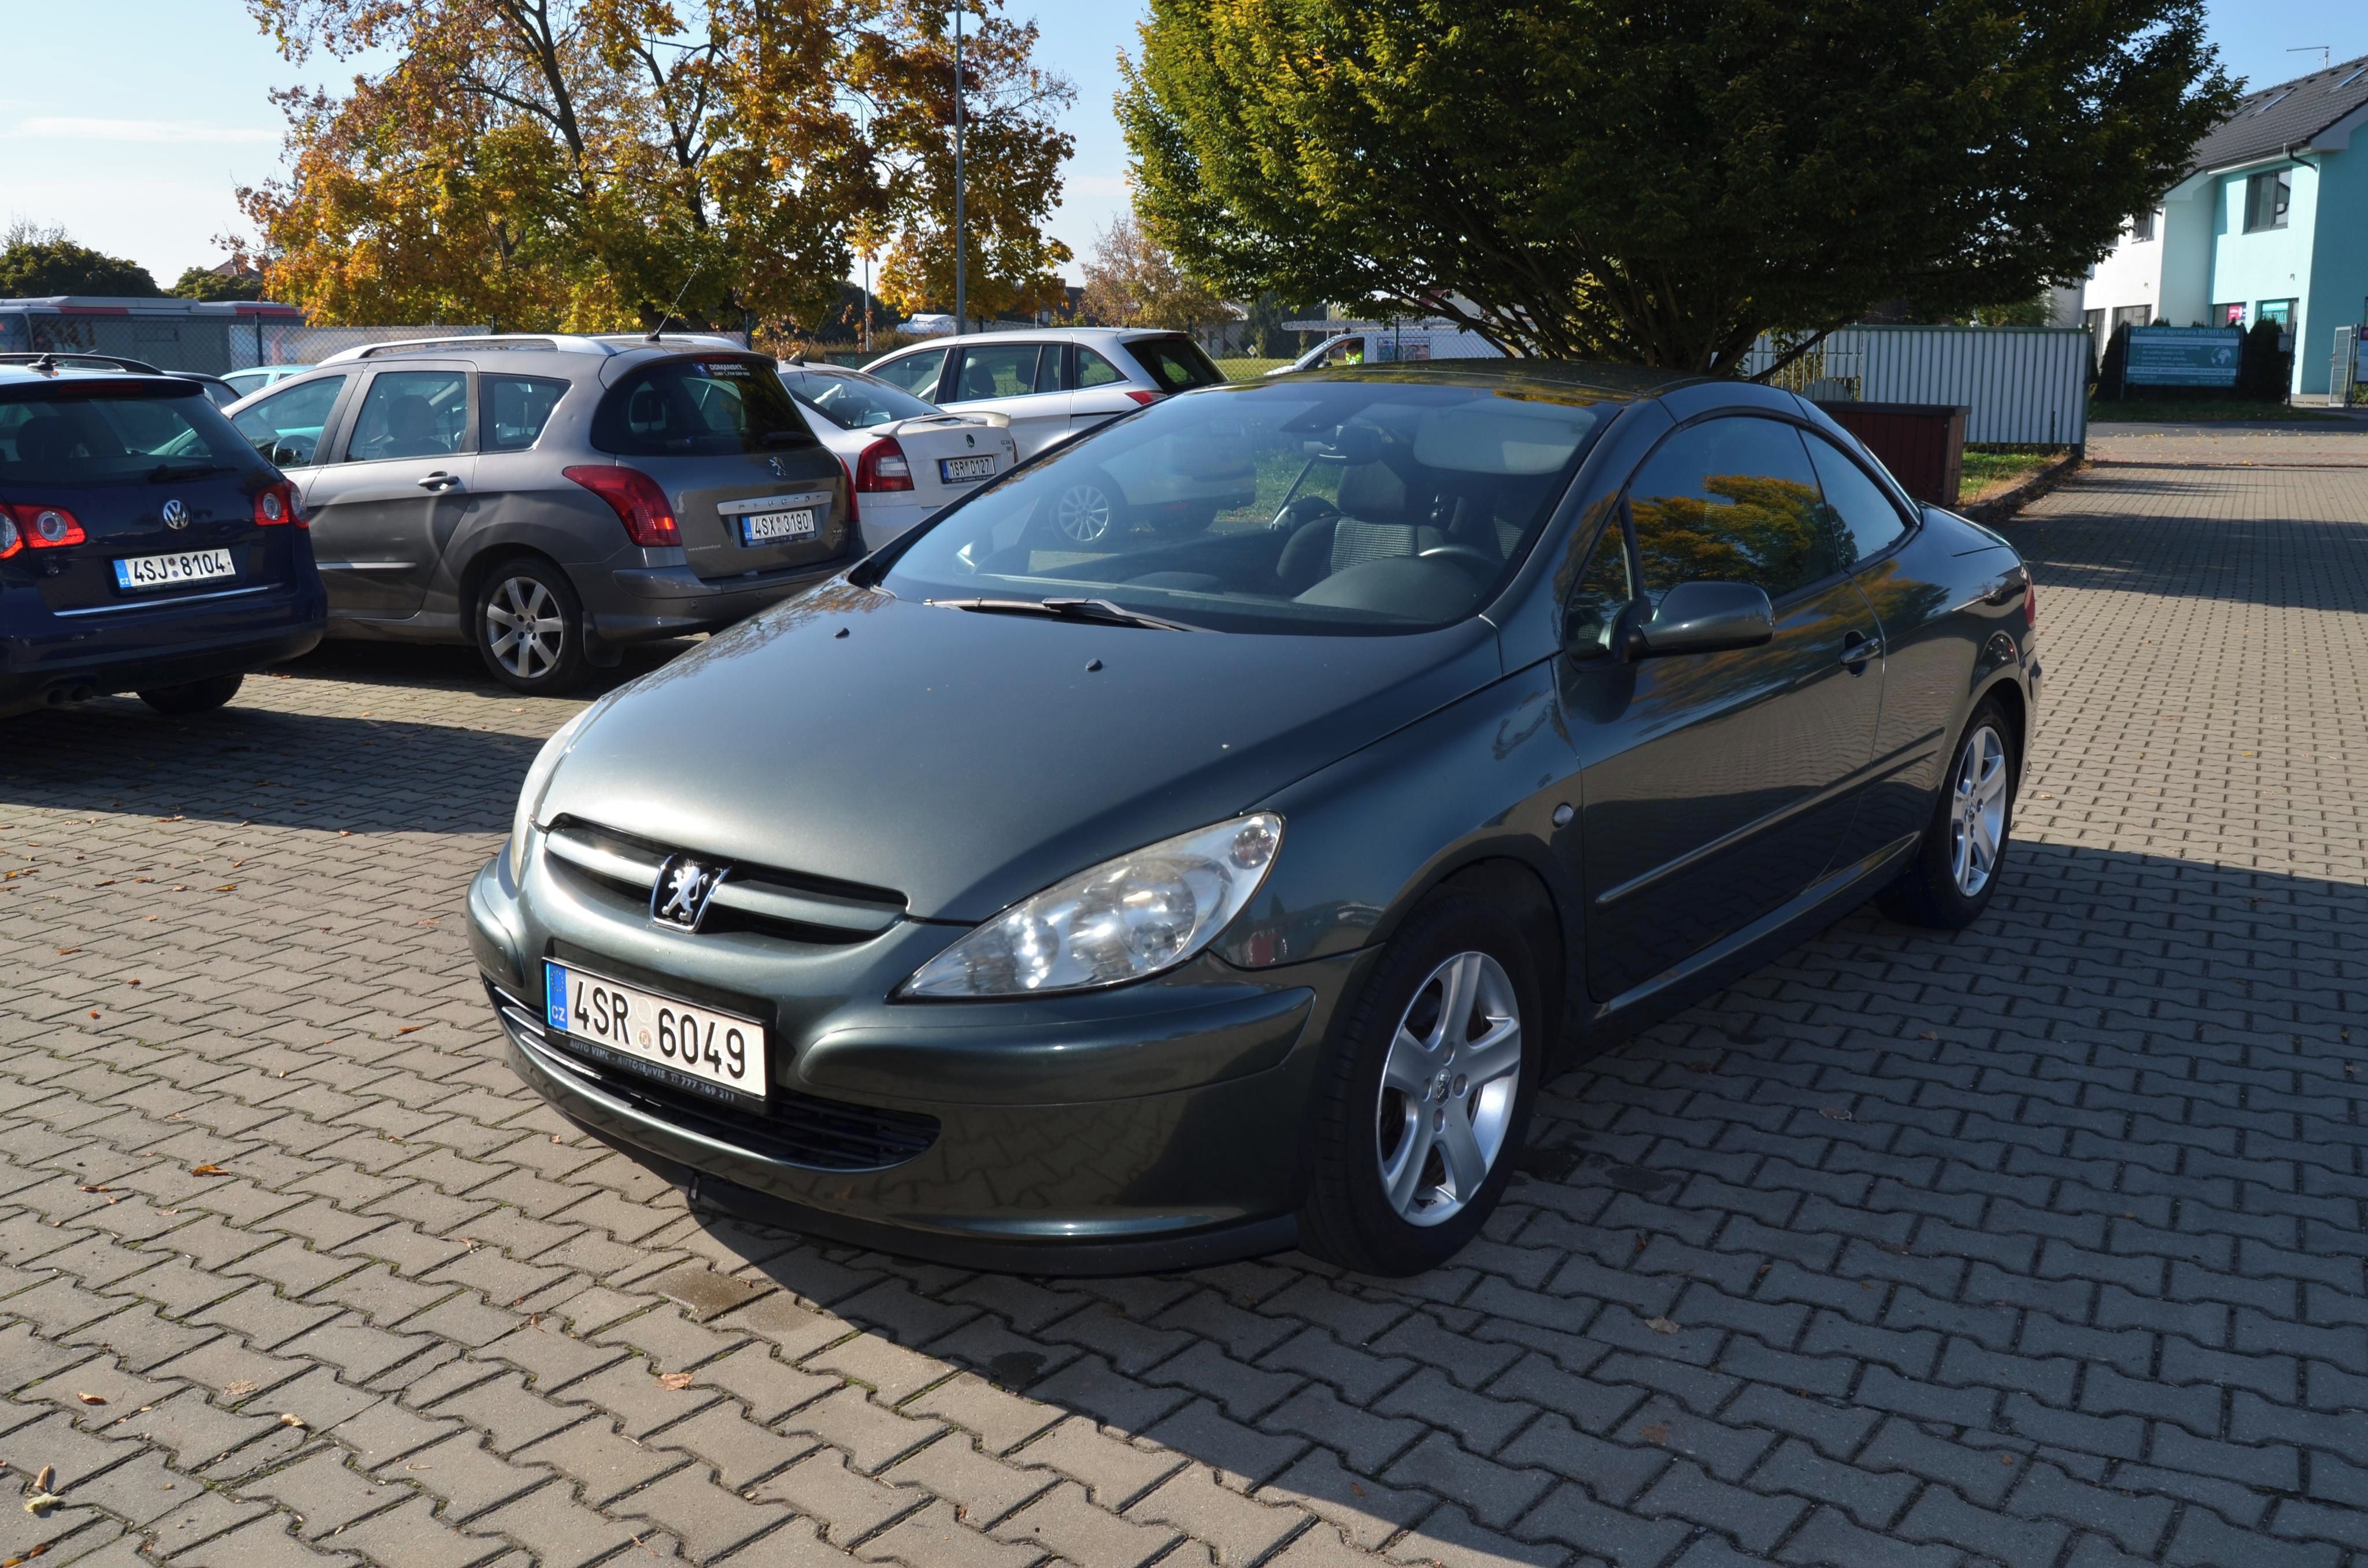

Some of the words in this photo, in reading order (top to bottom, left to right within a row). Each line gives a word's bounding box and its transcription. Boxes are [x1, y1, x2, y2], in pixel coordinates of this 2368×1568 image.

[2199, 328, 2237, 336] BOHEMIA
[949, 462, 965, 477] 1SR
[970, 459, 989, 474] 0127
[753, 517, 776, 537] 4SX
[782, 513, 809, 533] 3190
[134, 558, 168, 583] 4SJ
[180, 553, 225, 576] 8104
[551, 1004, 566, 1022] CZ
[574, 981, 631, 1046] 4SR
[658, 1007, 746, 1079] 6049
[569, 1040, 589, 1052] AUTO
[617, 1056, 665, 1079] AUTOSERVIS
[681, 1077, 697, 1089] 777
[719, 1089, 734, 1102] 211
